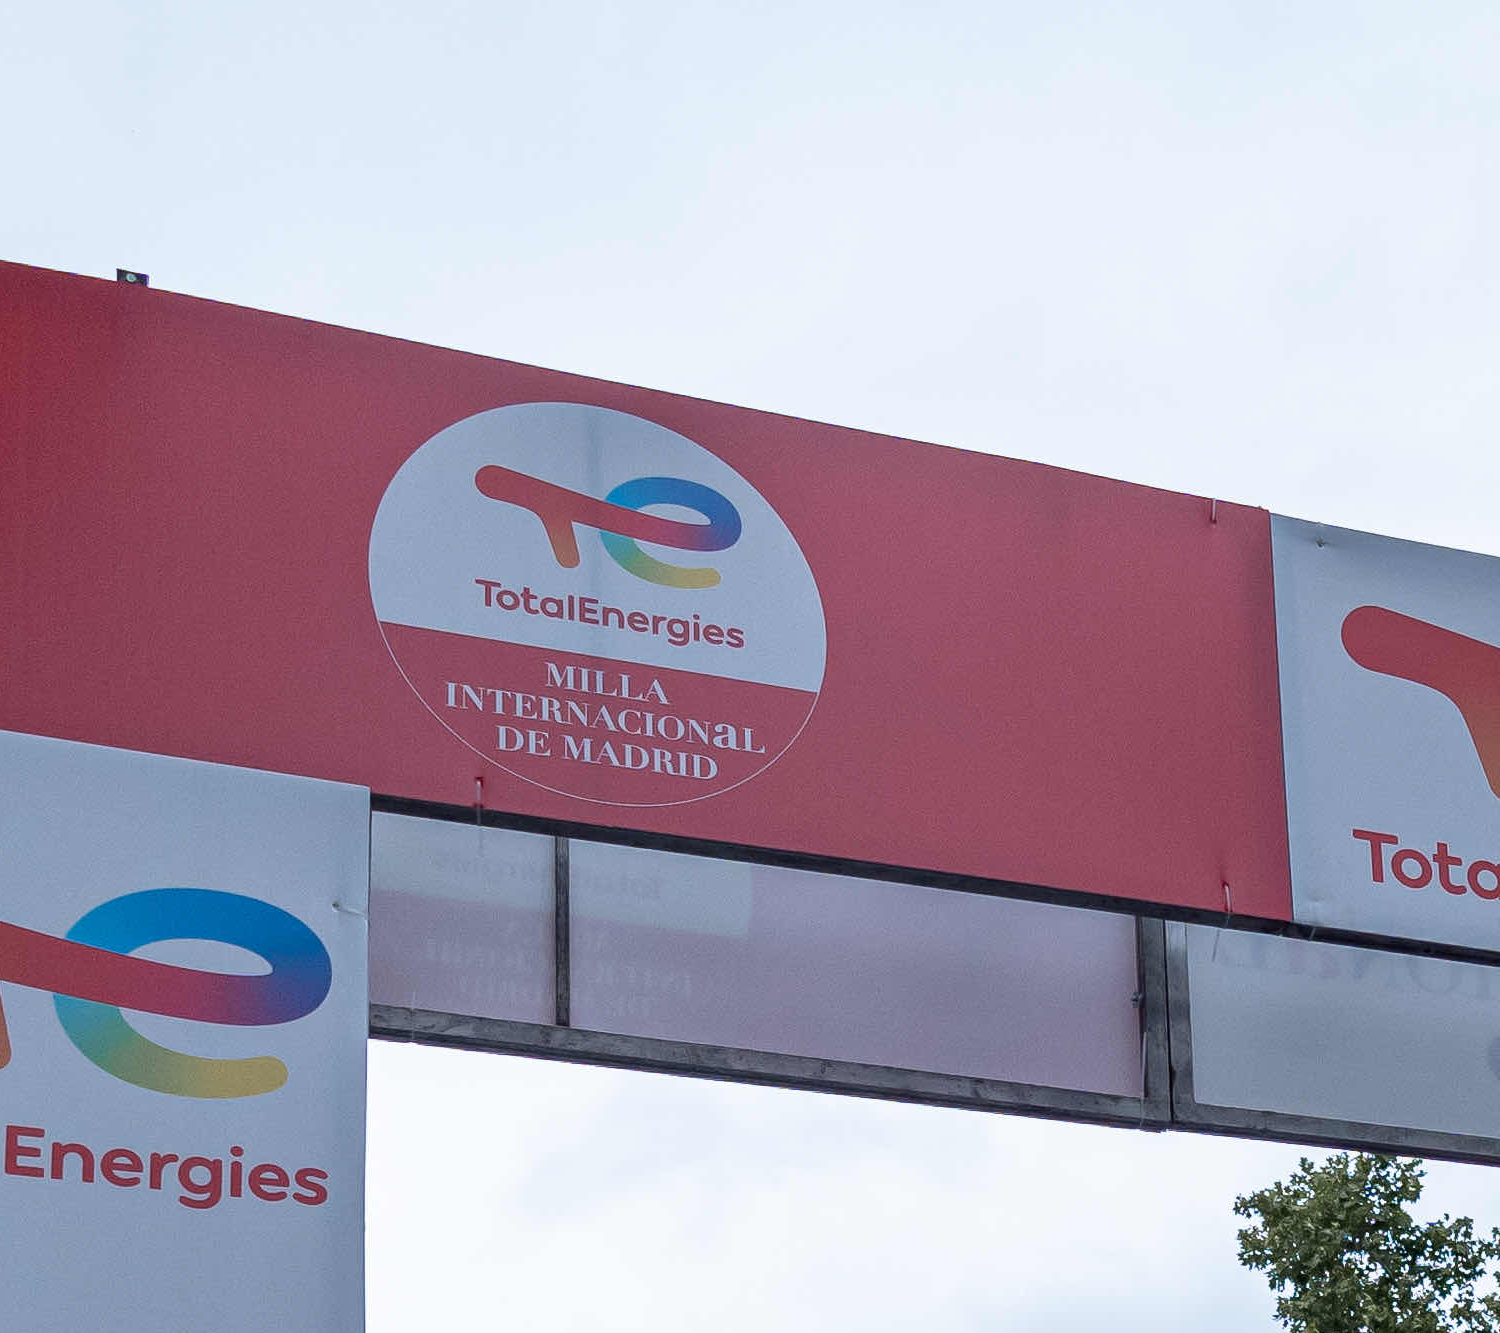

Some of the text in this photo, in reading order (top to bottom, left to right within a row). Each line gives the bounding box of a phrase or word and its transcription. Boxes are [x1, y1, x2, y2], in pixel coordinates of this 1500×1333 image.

[475, 578, 745, 650] TotalEnergies
[545, 662, 670, 706] MILLA
[496, 725, 719, 780] DE MADRID
